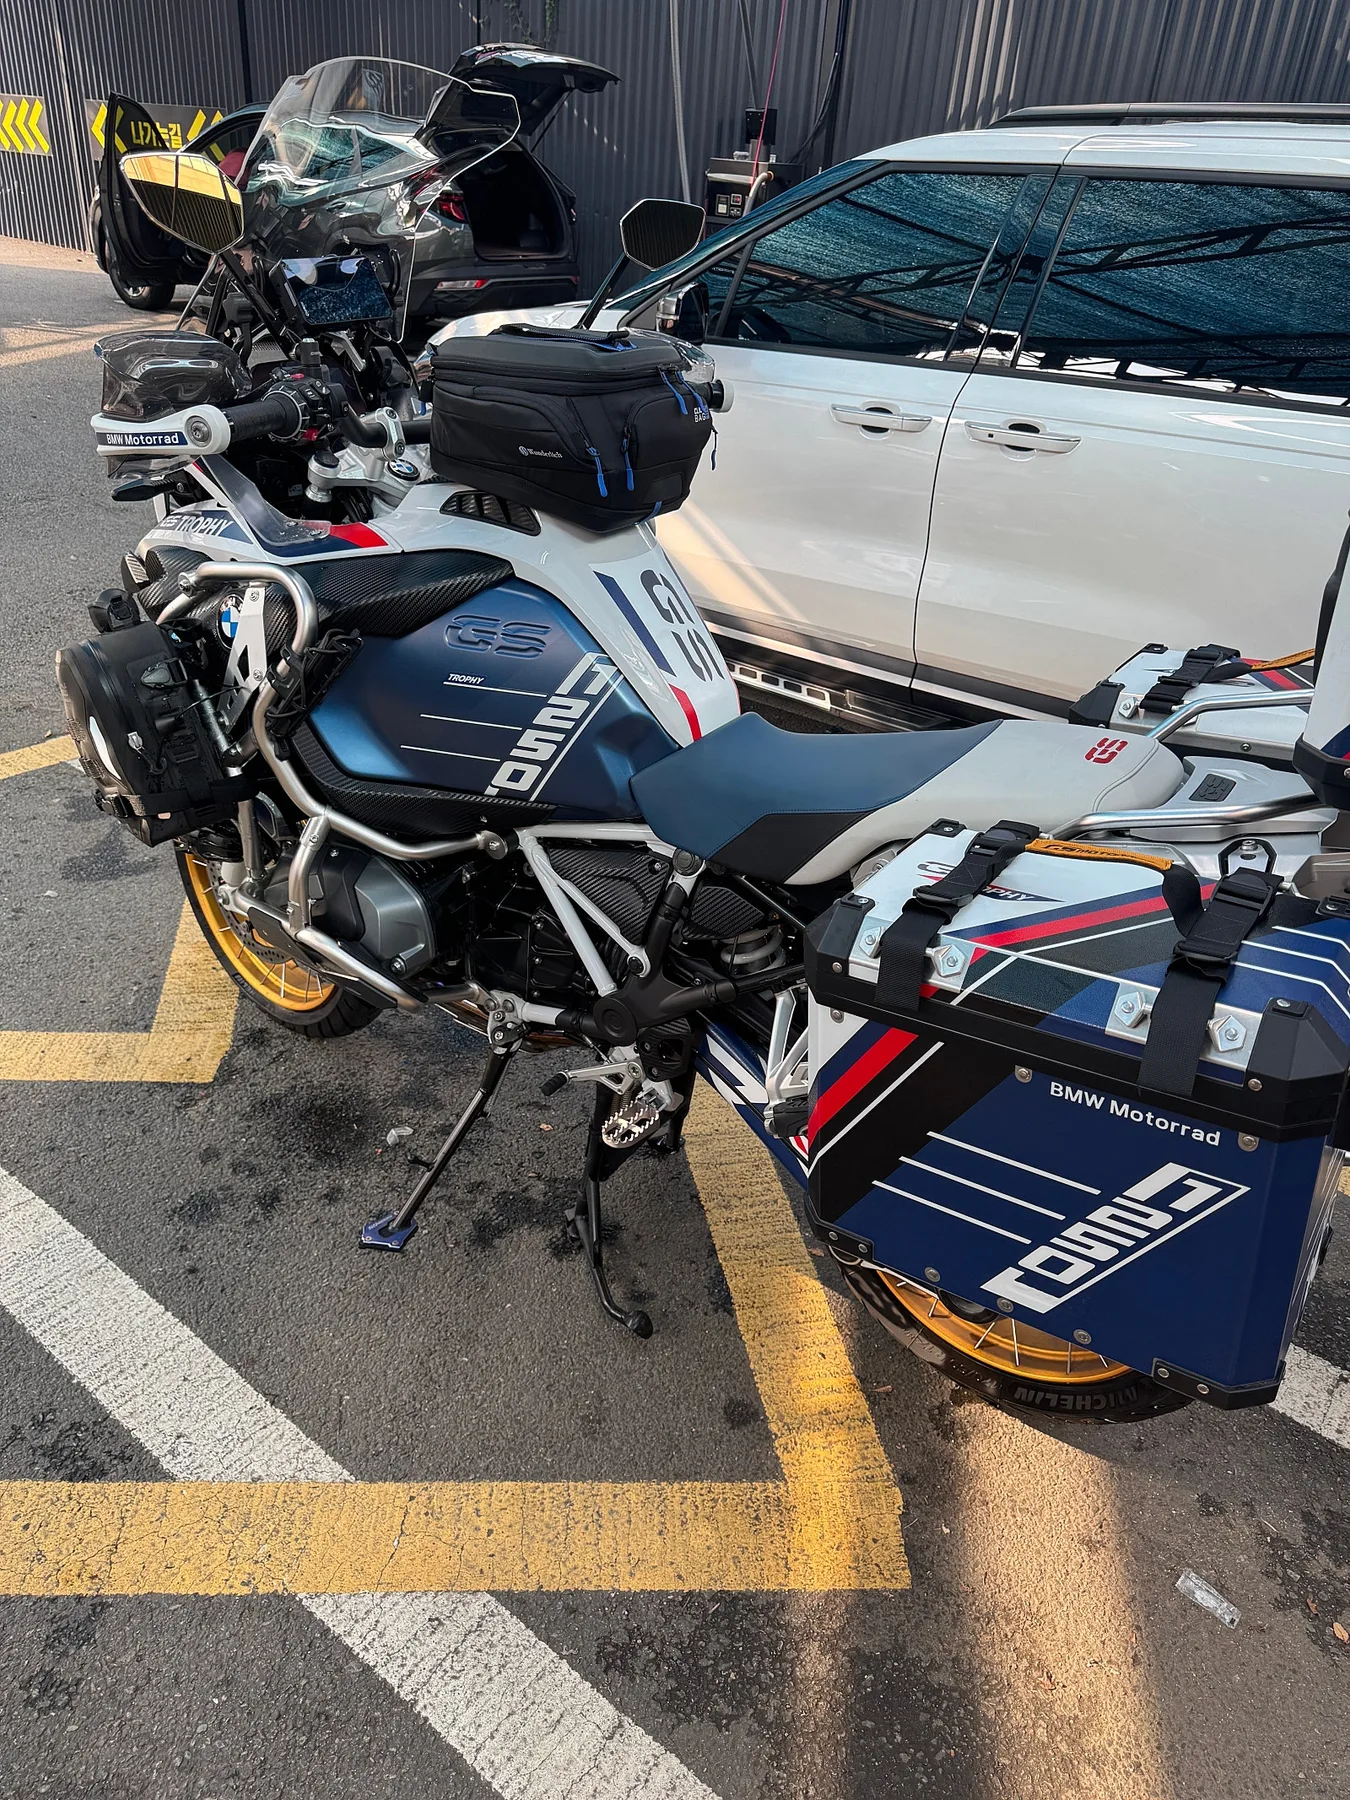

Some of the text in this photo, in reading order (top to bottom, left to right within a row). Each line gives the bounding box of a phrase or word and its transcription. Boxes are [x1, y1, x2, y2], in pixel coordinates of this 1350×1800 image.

[106, 432, 180, 446] BMW Motorrad
[175, 514, 235, 538] TROPHY
[443, 613, 551, 660] GS
[447, 672, 485, 686] TROPHY
[490, 662, 619, 792] 1250
[1049, 1081, 1222, 1147] BMW Motorrad
[1017, 1177, 1224, 1286] 1250
[1013, 1385, 1138, 1411] MICHELIN
